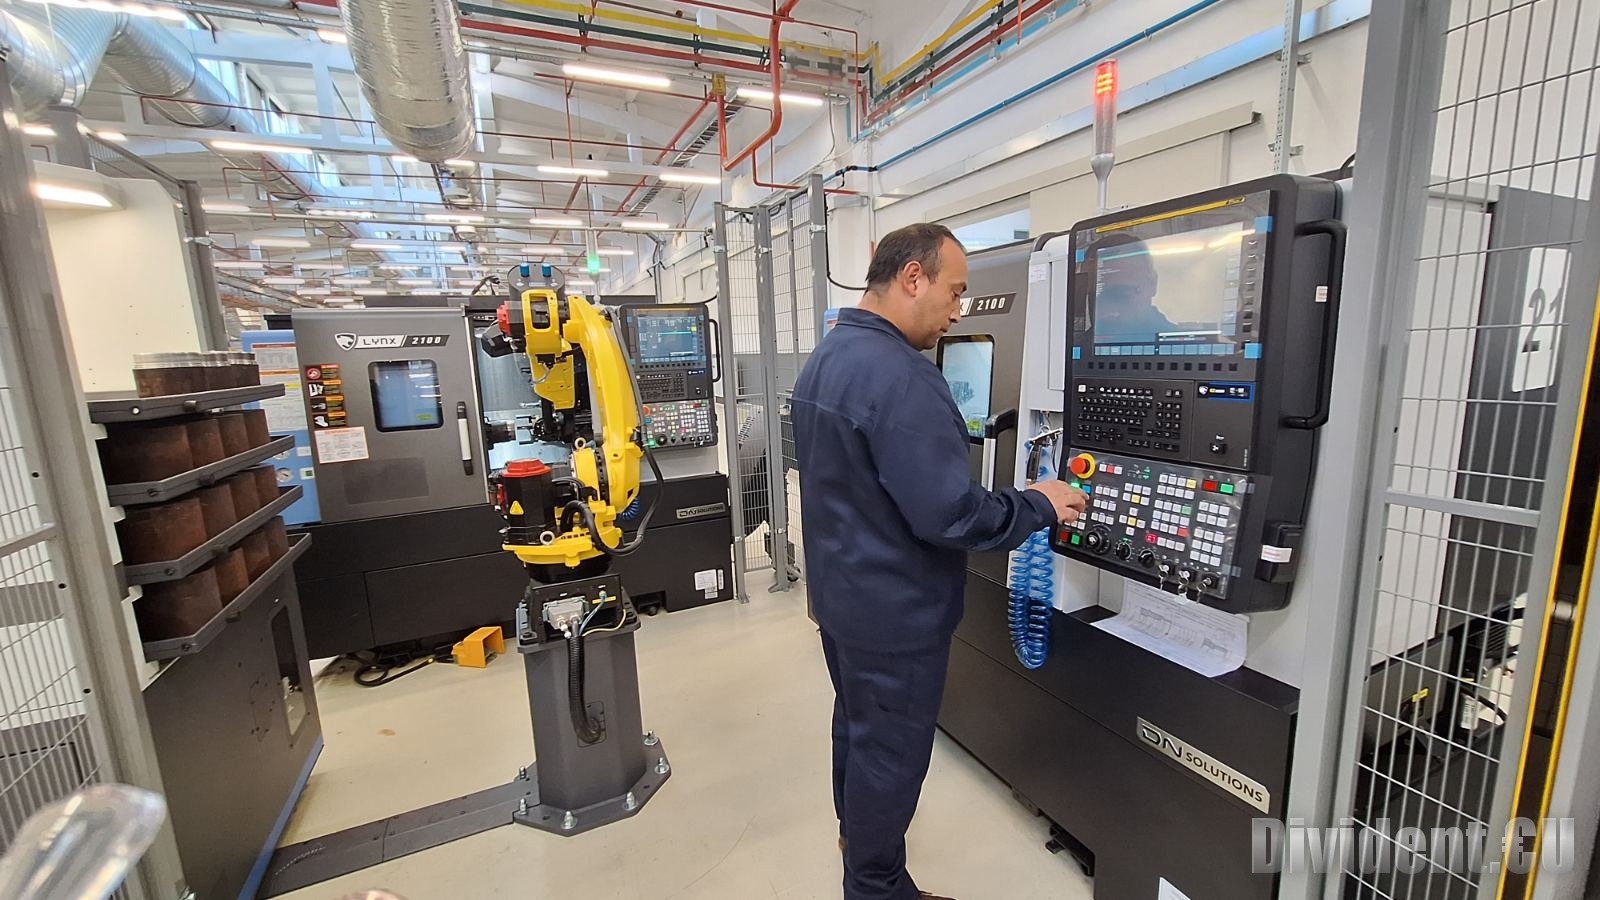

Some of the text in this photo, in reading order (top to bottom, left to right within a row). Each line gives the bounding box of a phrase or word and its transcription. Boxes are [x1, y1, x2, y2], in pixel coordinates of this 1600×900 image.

[977, 297, 1006, 311] 2100
[1521, 288, 1562, 353] 21
[411, 336, 442, 345] 2100
[1142, 725, 1263, 802] DN SOLUTIONS
